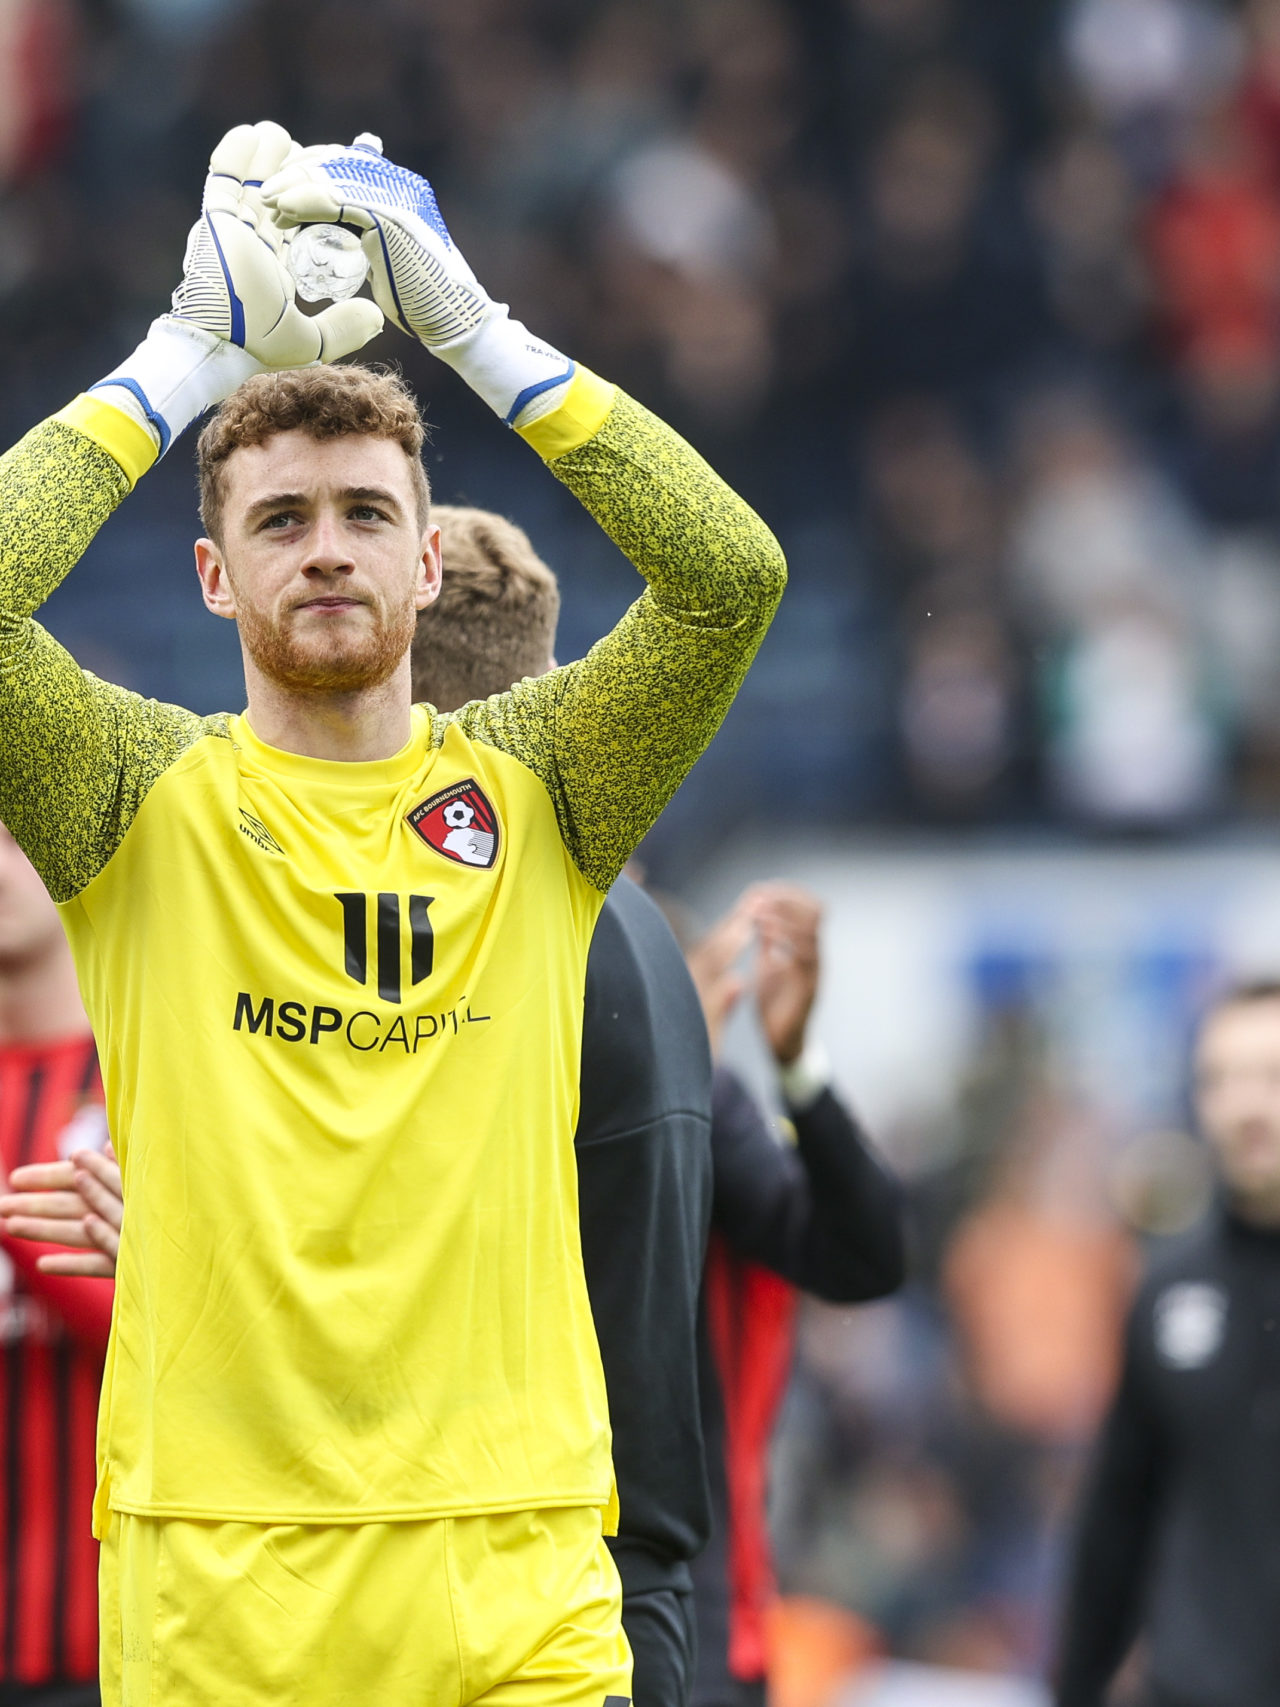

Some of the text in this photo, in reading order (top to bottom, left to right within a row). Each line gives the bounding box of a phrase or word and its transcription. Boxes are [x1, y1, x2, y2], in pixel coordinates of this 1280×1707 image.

[413, 783, 472, 822] AFC BOURNEMOUTH
[239, 823, 275, 855] umbr
